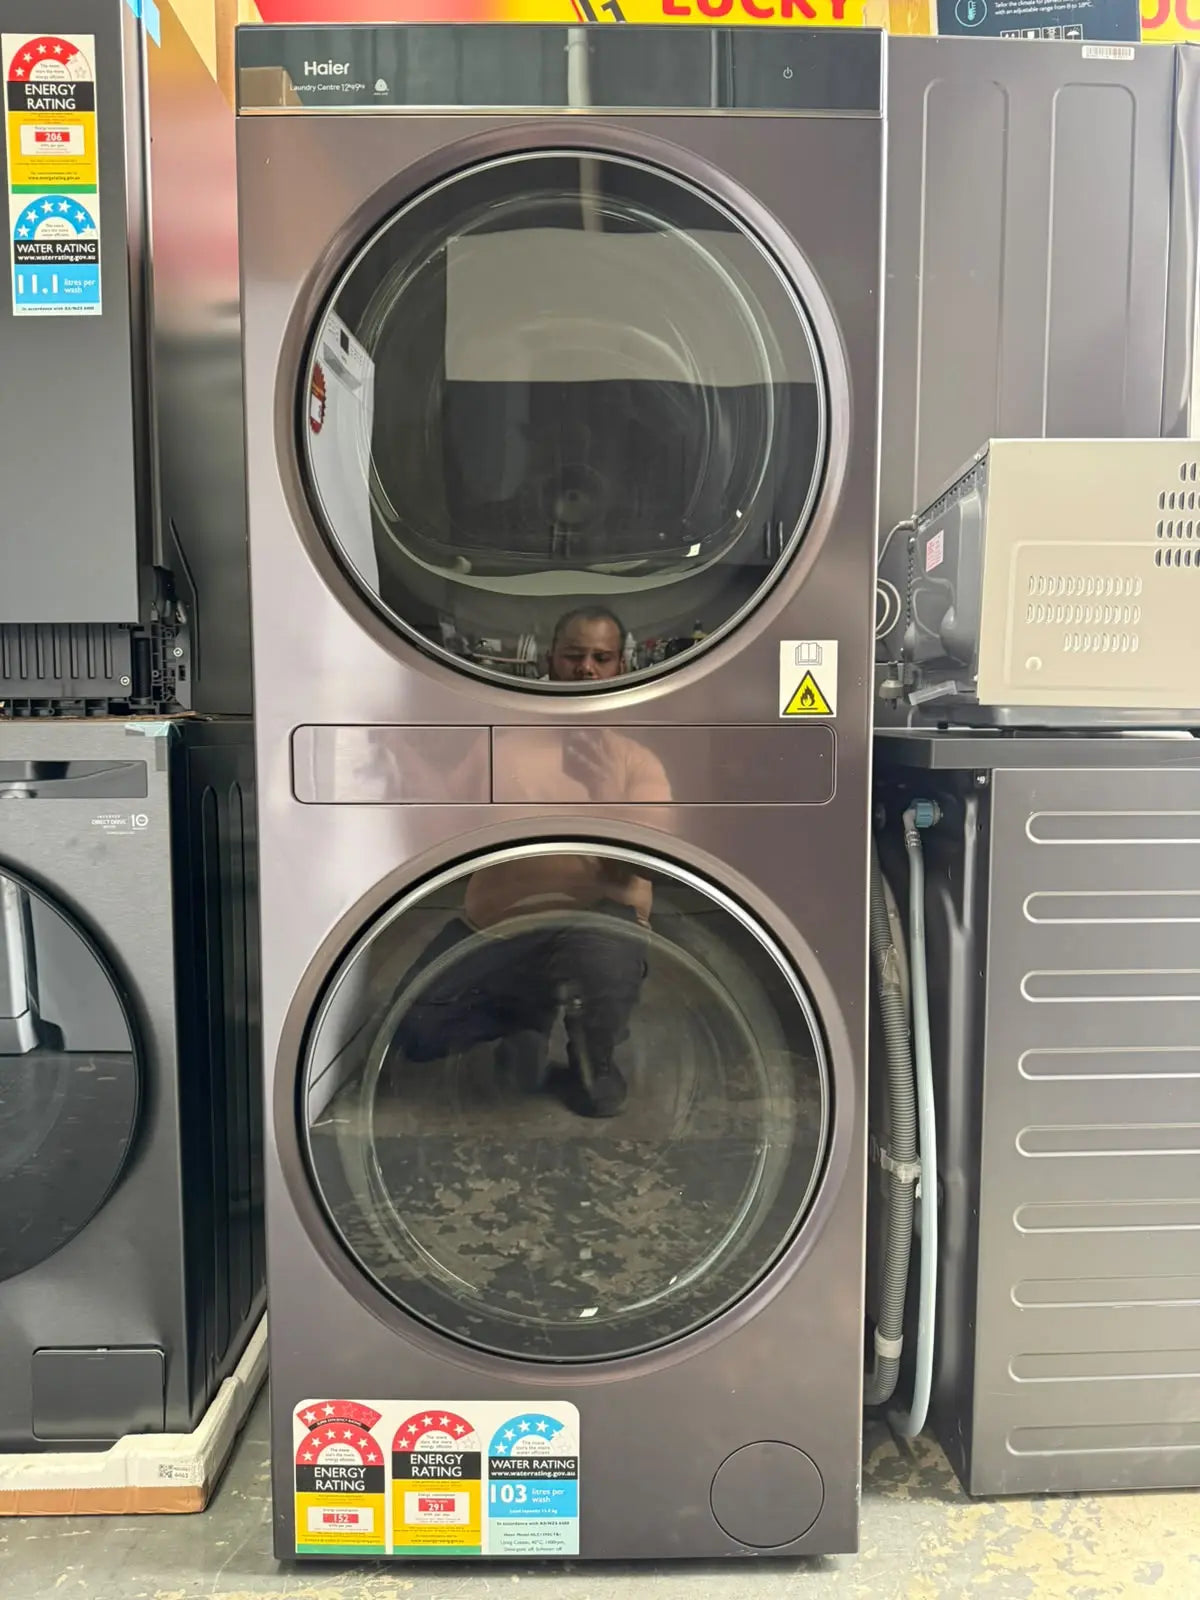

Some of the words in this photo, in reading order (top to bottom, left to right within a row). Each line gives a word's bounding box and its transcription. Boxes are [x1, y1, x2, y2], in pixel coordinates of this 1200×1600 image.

[304, 60, 350, 76] Haier
[25, 83, 76, 95] ENERGY
[290, 84, 317, 92] Laundry
[27, 98, 76, 110] RATING
[45, 133, 62, 141] 206
[17, 243, 53, 253] WATER
[56, 243, 95, 253] RATING
[18, 254, 96, 262] www.waterrating.gov.au
[18, 274, 58, 294] 11.1
[64, 278, 81, 286] litres
[83, 279, 95, 287] per
[410, 1454, 463, 1465] ENERGY
[491, 1460, 530, 1469] WATER
[533, 1460, 575, 1469] RATING
[314, 1467, 366, 1478] ENERGY
[412, 1466, 462, 1477] RATING
[491, 1470, 576, 1478] www.waterrating.gov.au
[315, 1480, 366, 1491] RATING
[490, 1484, 527, 1503] 103
[428, 1503, 444, 1511] 291
